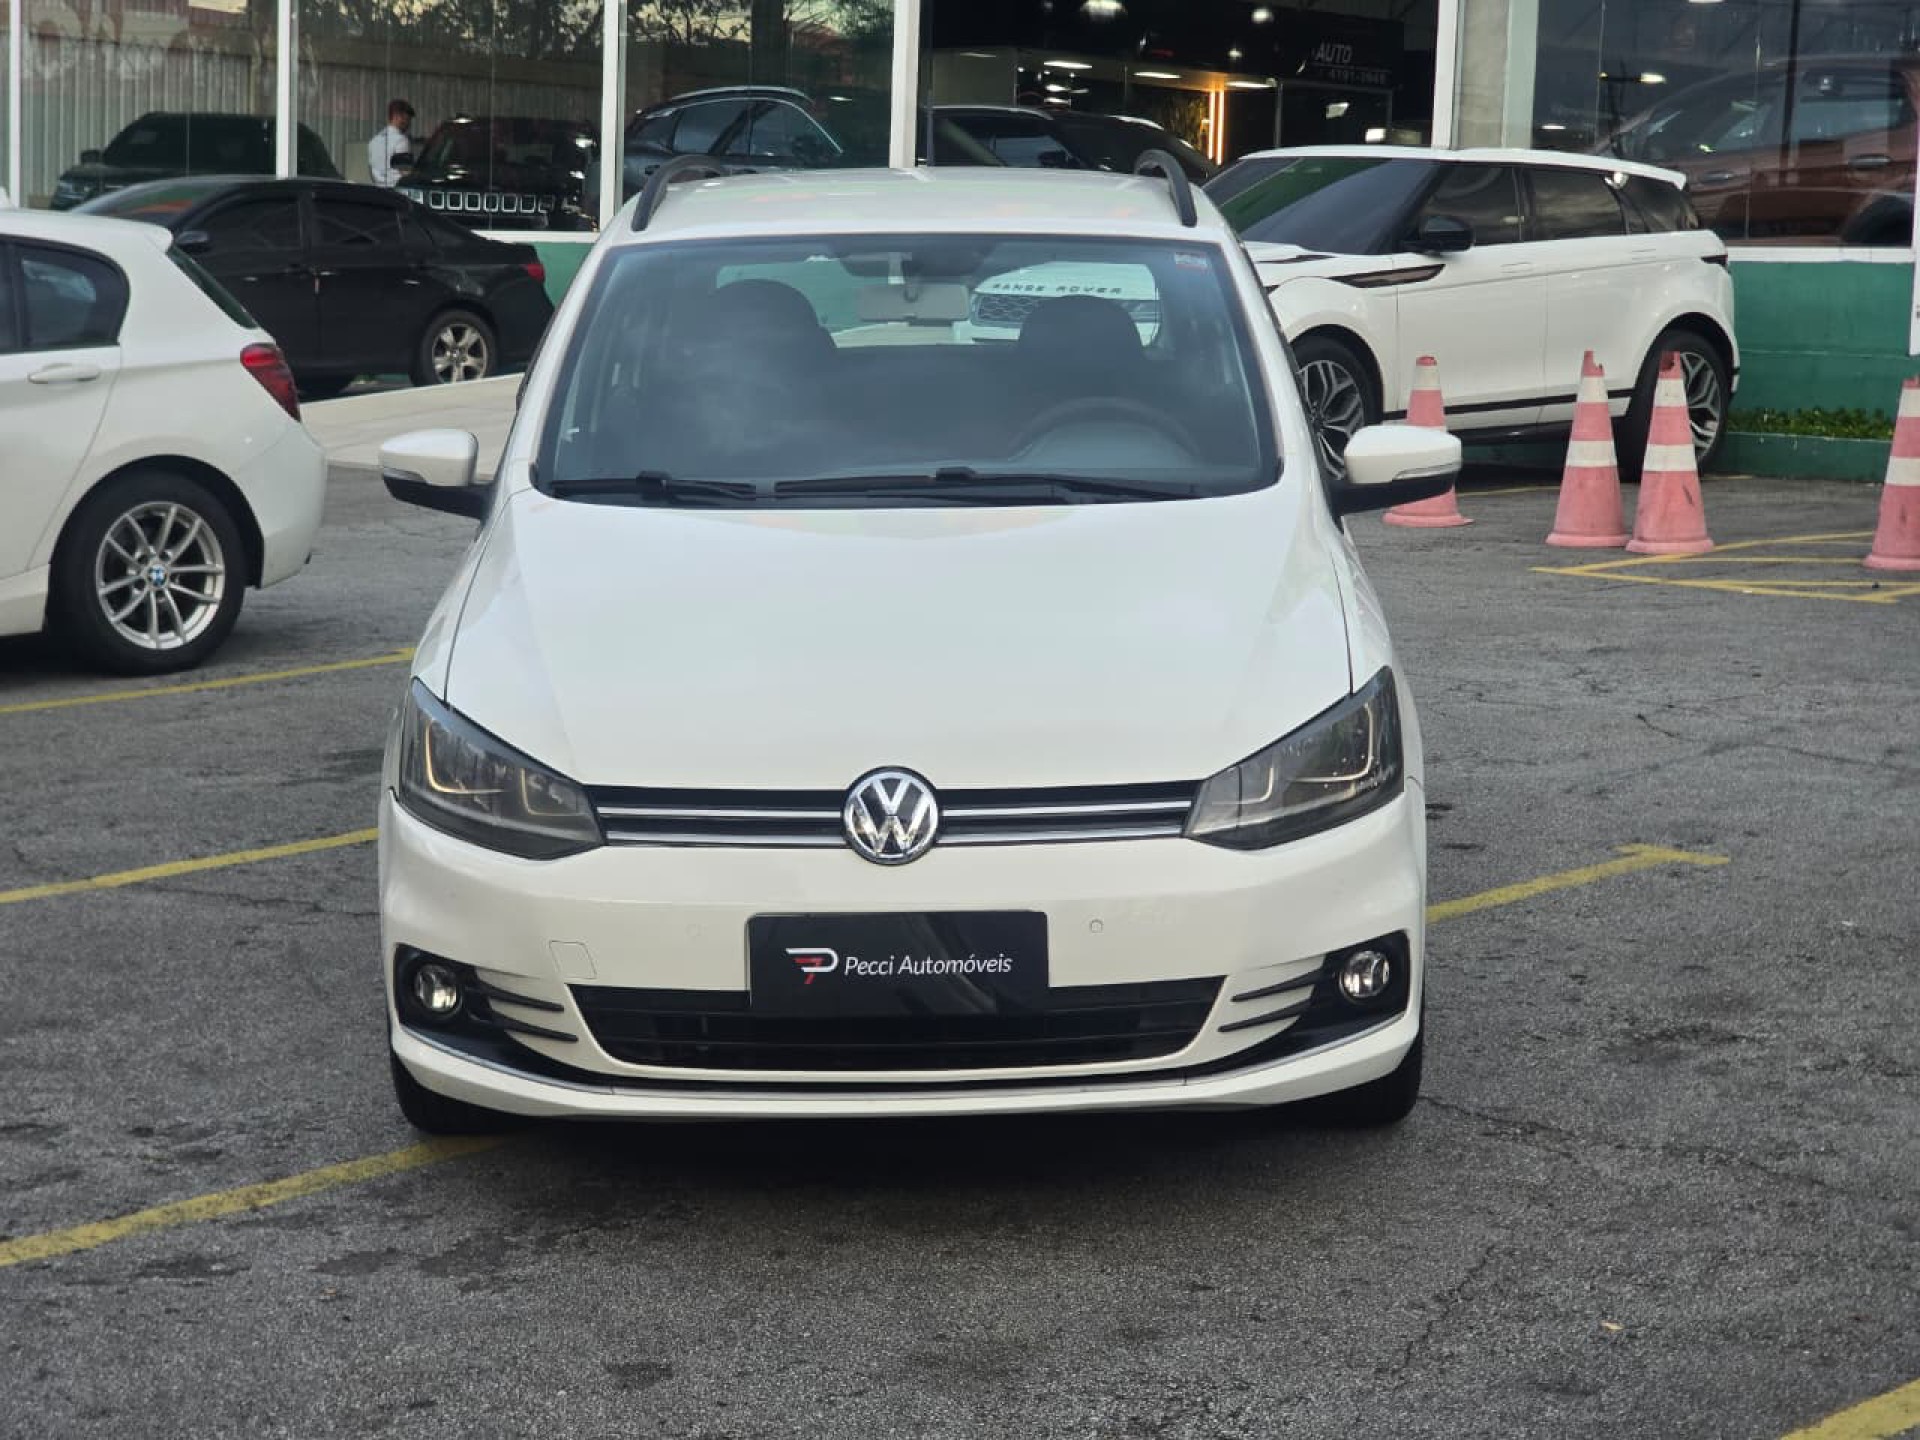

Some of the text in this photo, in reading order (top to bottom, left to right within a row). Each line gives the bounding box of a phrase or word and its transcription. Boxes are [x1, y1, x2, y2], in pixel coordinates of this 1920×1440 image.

[992, 284, 1123, 294] RANGE ROVER
[844, 955, 893, 976] Pecci
[897, 953, 1013, 976] Automóveis
